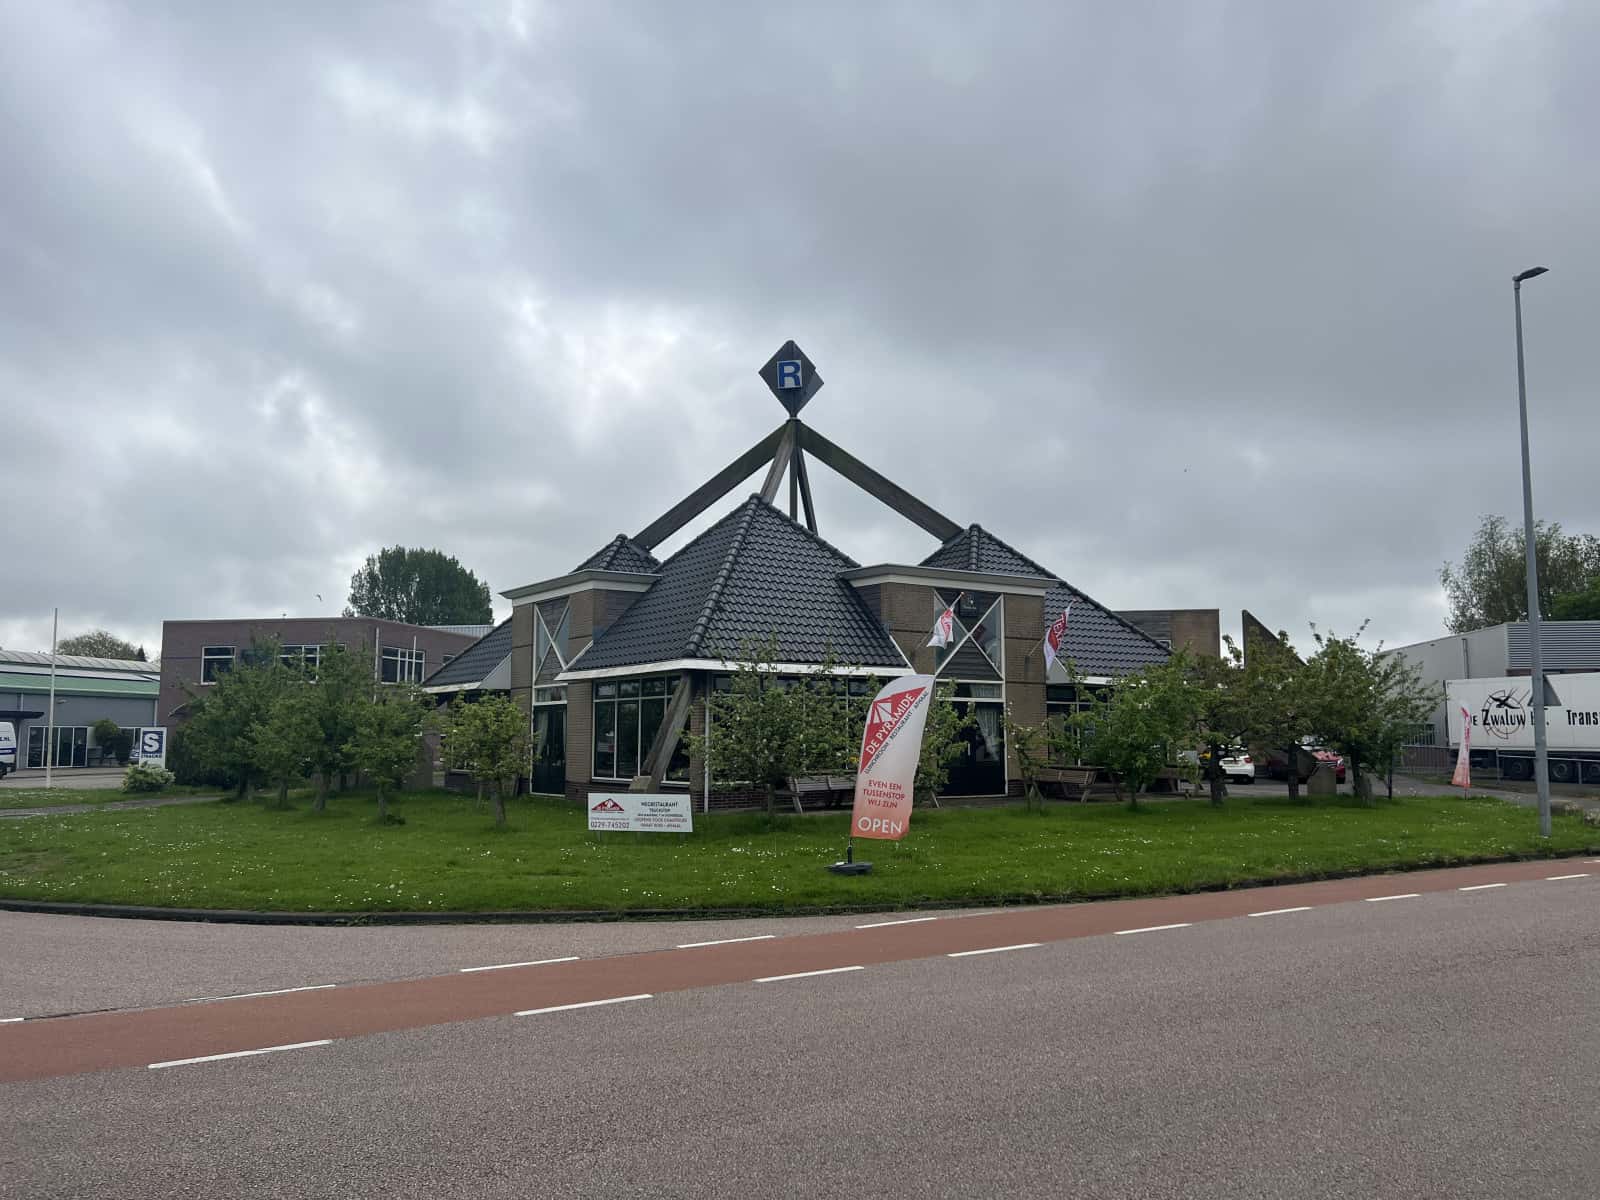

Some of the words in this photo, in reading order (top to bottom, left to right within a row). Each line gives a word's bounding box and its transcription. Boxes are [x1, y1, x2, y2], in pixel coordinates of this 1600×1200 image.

[778, 361, 801, 388] R
[865, 739, 880, 755] DE
[875, 693, 915, 741] PYRAMIDE
[1566, 709, 1600, 726] Trans
[143, 733, 160, 752] S
[869, 780, 887, 788] EVEN
[864, 789, 905, 800] TUSSENSTOP
[868, 799, 880, 807] WIJ
[857, 816, 902, 834] OPEN
